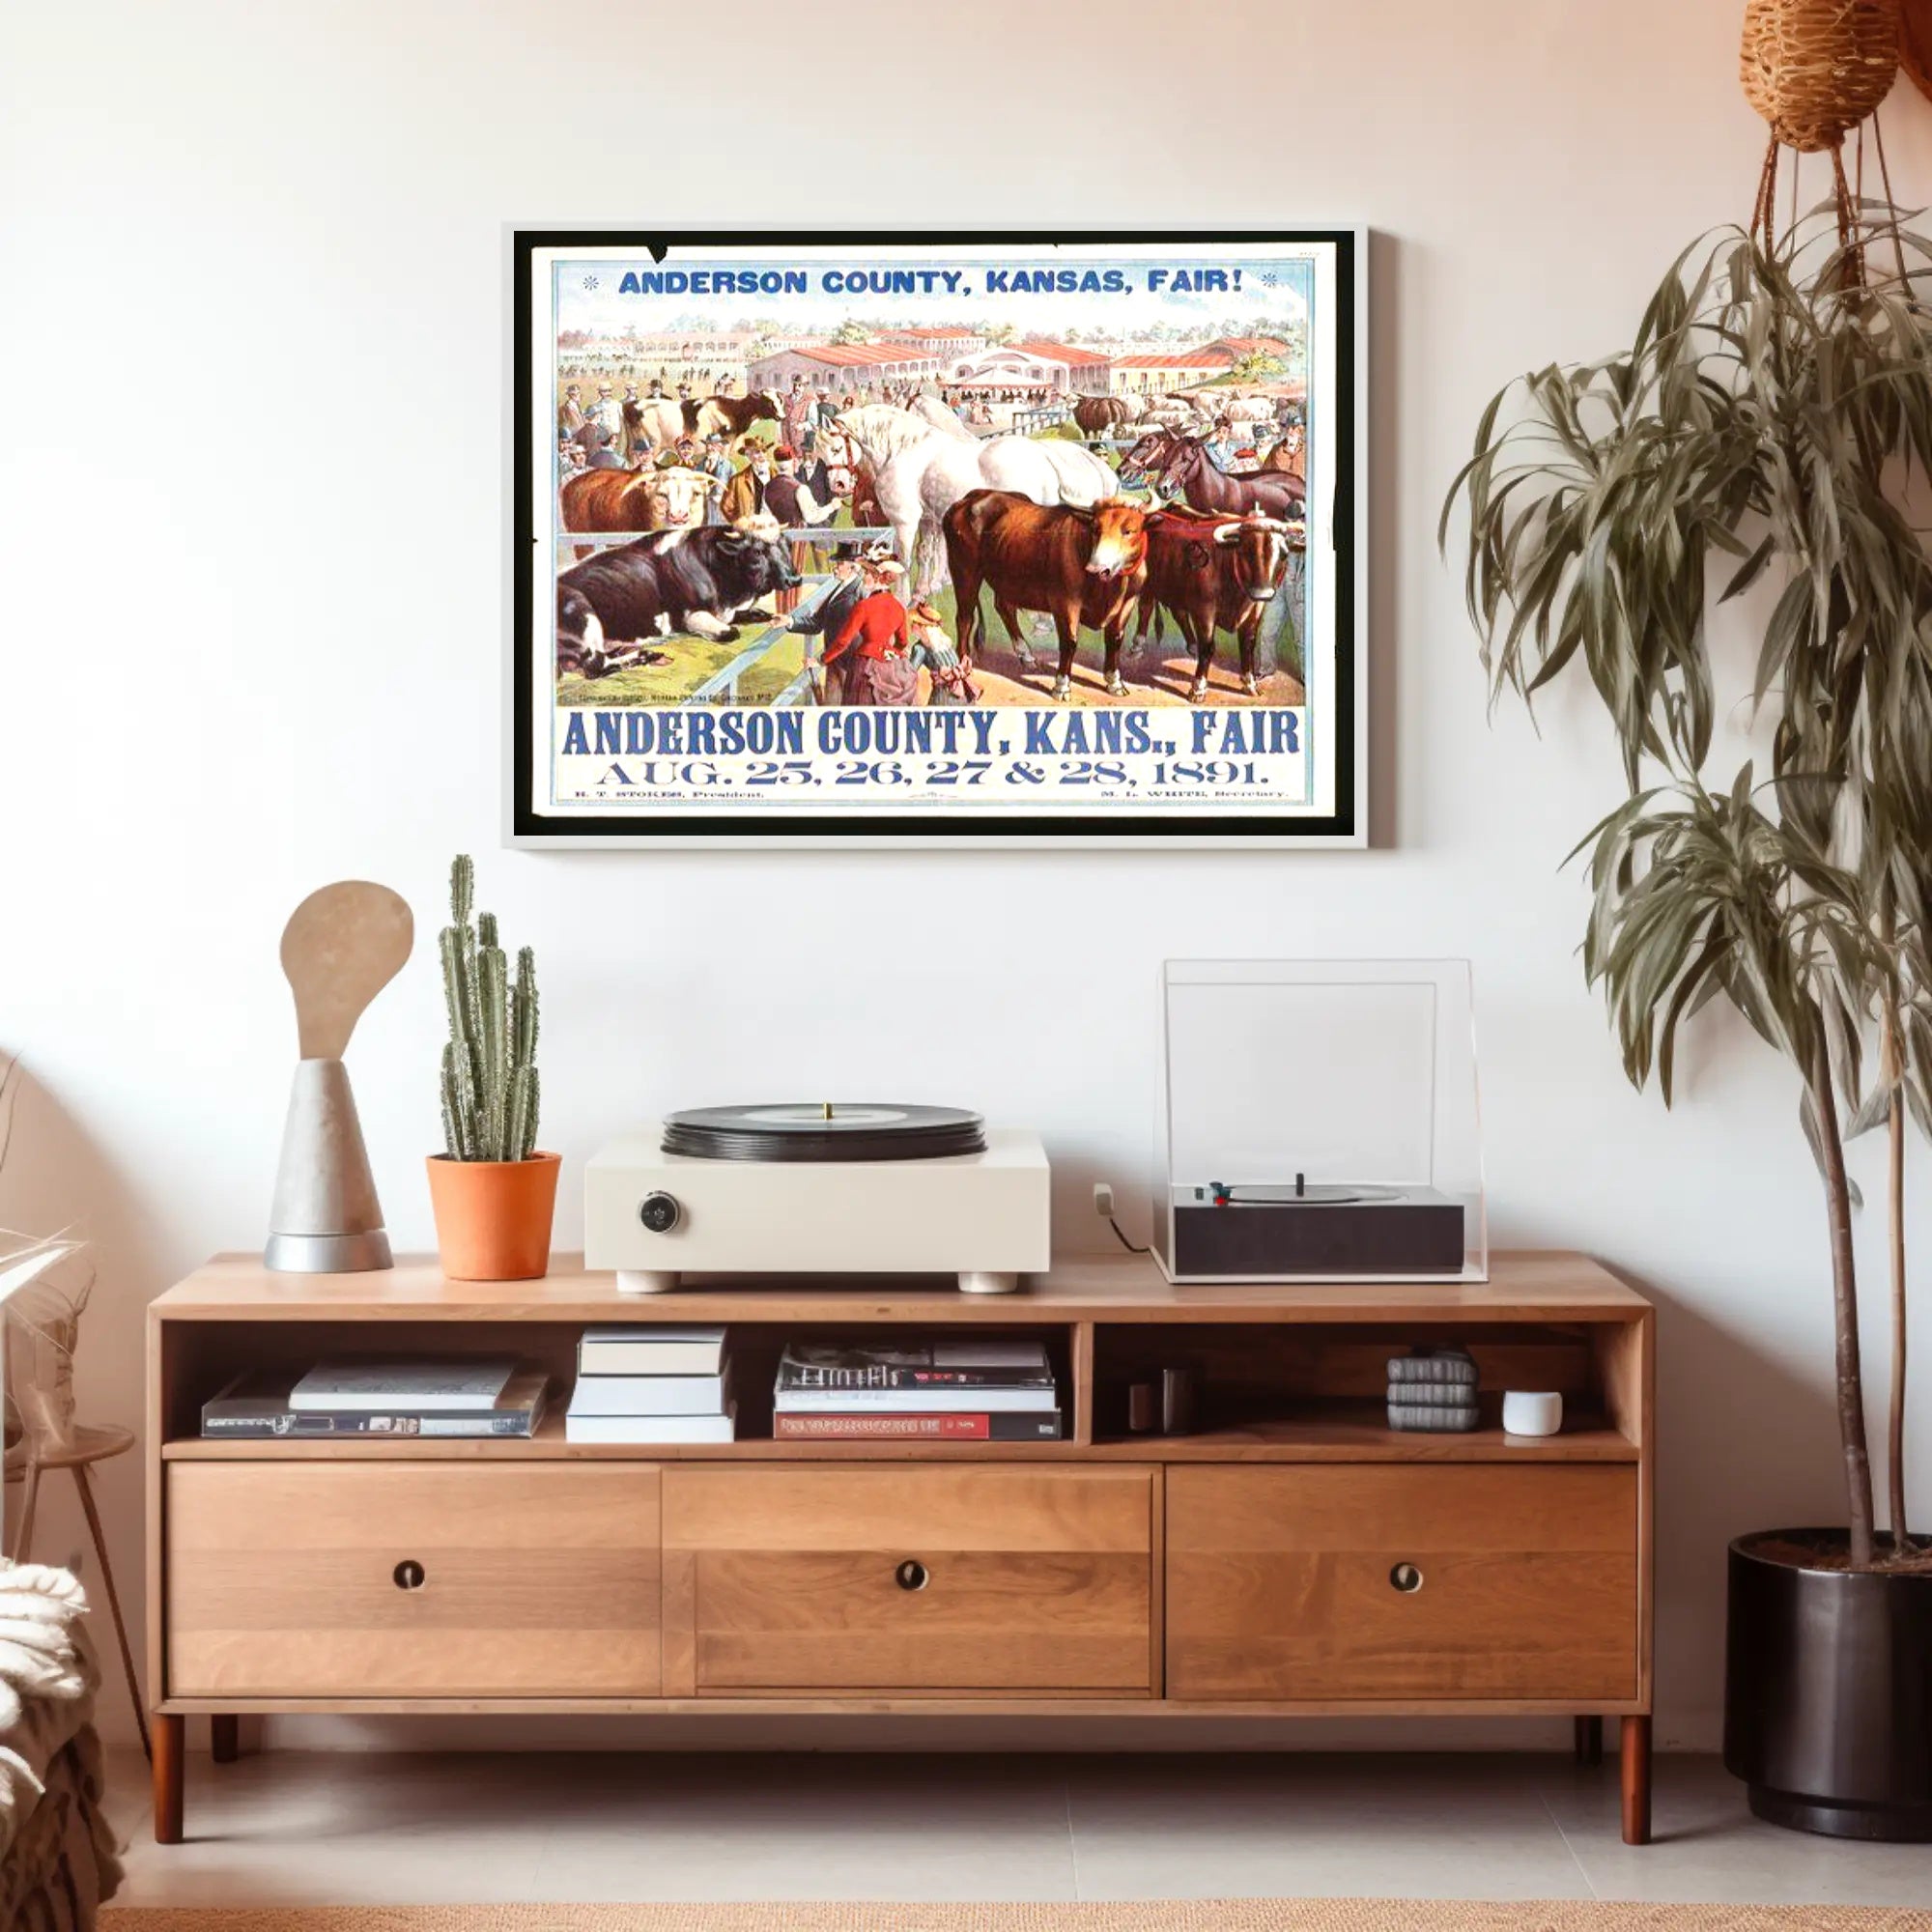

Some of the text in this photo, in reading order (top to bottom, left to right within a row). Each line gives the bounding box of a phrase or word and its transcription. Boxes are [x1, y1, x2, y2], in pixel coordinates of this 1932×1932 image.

[618, 269, 1242, 298] ANDERSON COUNTY, KANSAS, FAIR!
[561, 710, 1300, 757] ANDERSON COUNTY, KANS., FAIR
[596, 760, 1268, 787] AUG. 25, 26, 27 & 28, 1891.
